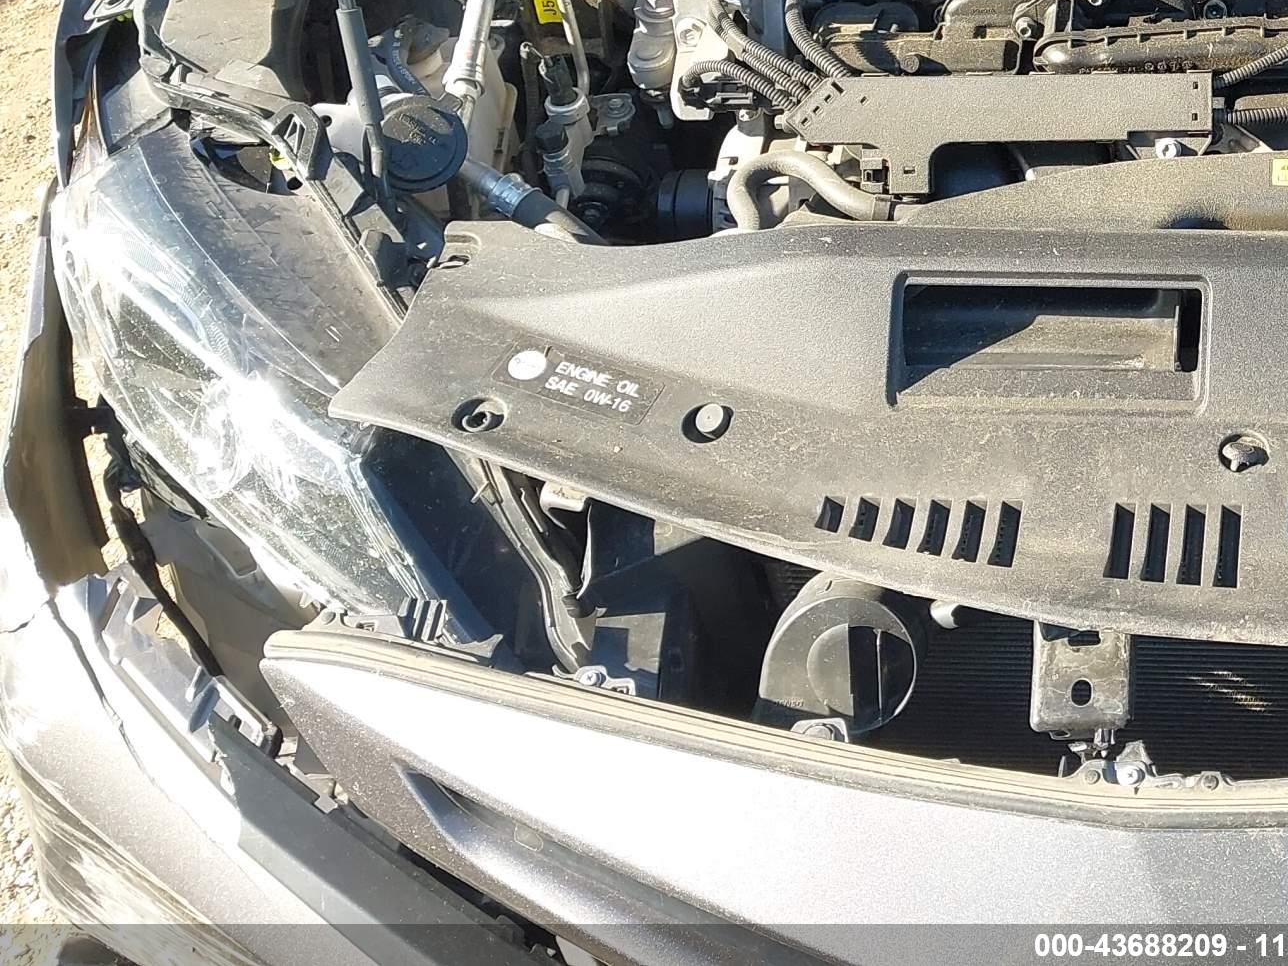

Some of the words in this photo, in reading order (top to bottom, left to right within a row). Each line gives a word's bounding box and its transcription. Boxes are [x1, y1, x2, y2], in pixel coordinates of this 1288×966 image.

[541, 0, 557, 16] J5
[544, 375, 579, 396] SAE
[583, 388, 632, 412] 0W-16
[555, 361, 614, 388] ENGINE
[616, 379, 640, 398] OIL
